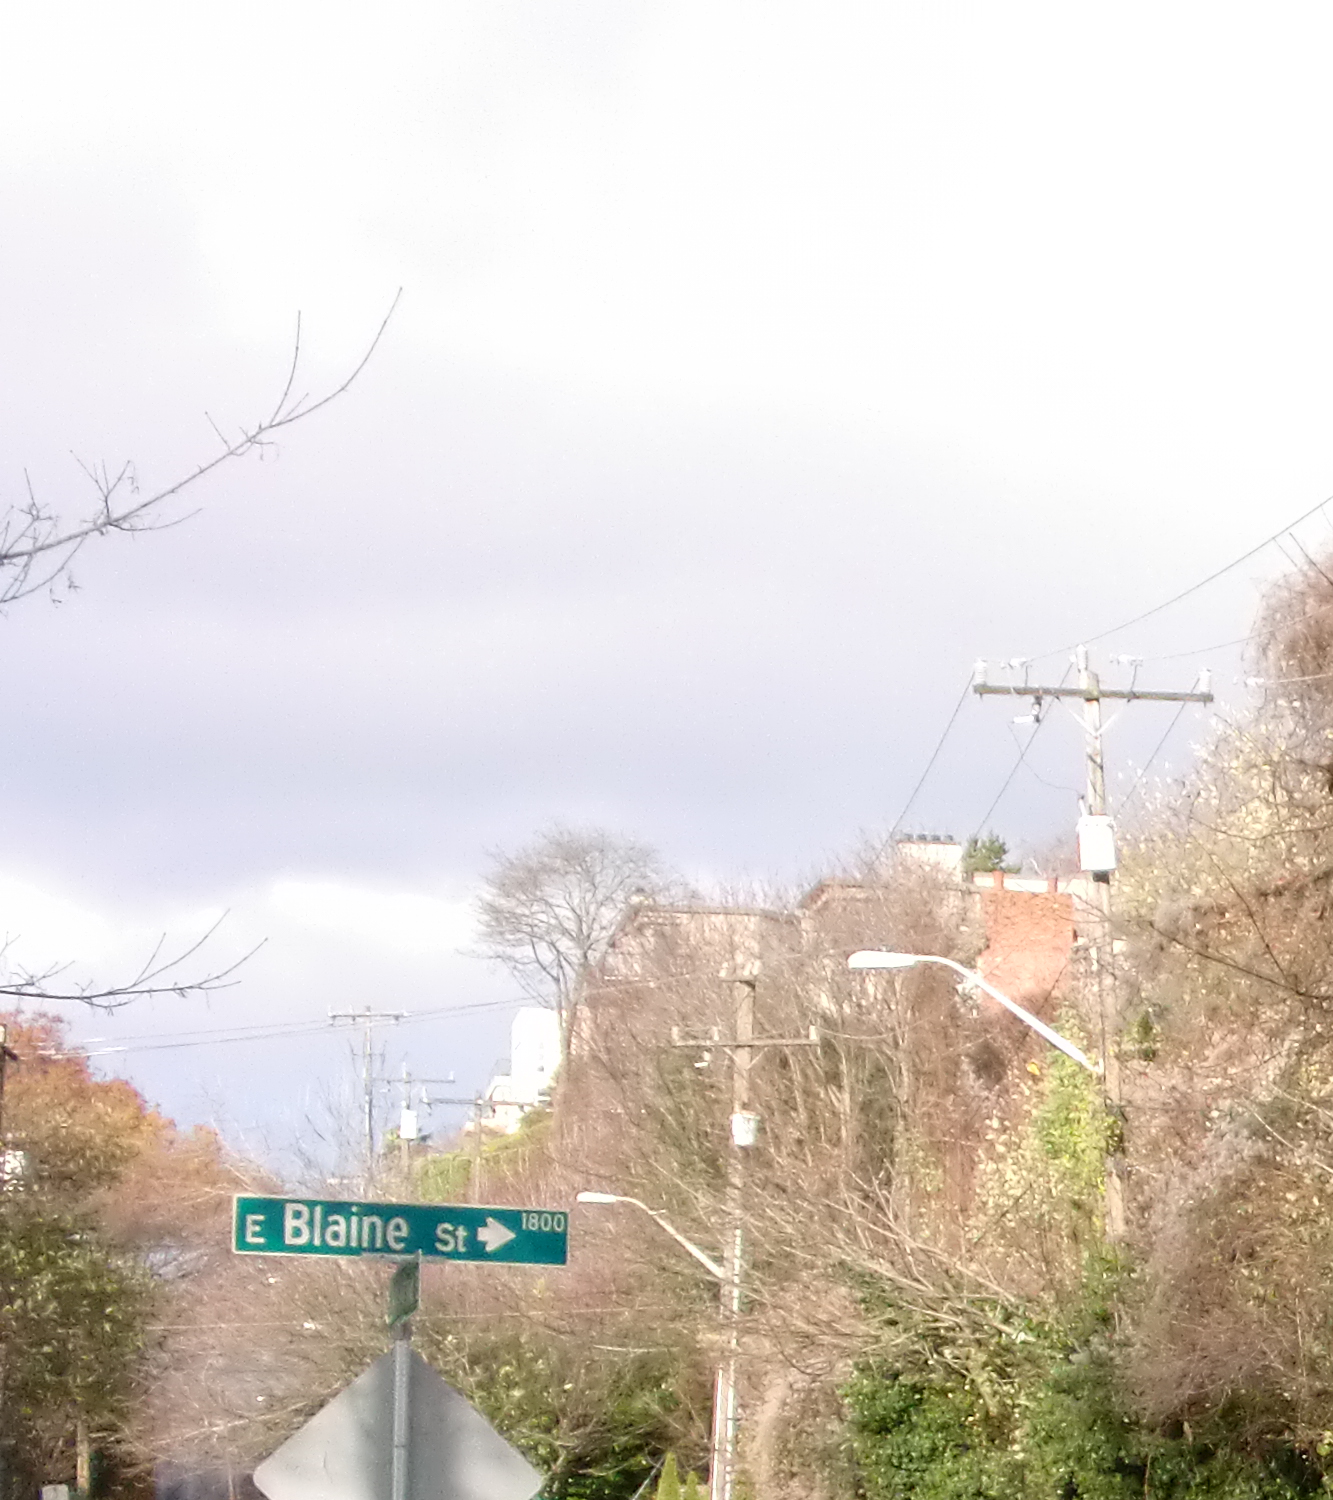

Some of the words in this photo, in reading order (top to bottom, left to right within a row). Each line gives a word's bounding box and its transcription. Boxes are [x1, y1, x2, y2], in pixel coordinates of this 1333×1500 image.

[244, 1214, 266, 1244] E
[284, 1202, 409, 1251] Blaine
[435, 1222, 468, 1253] St
[521, 1212, 565, 1232] 1800
